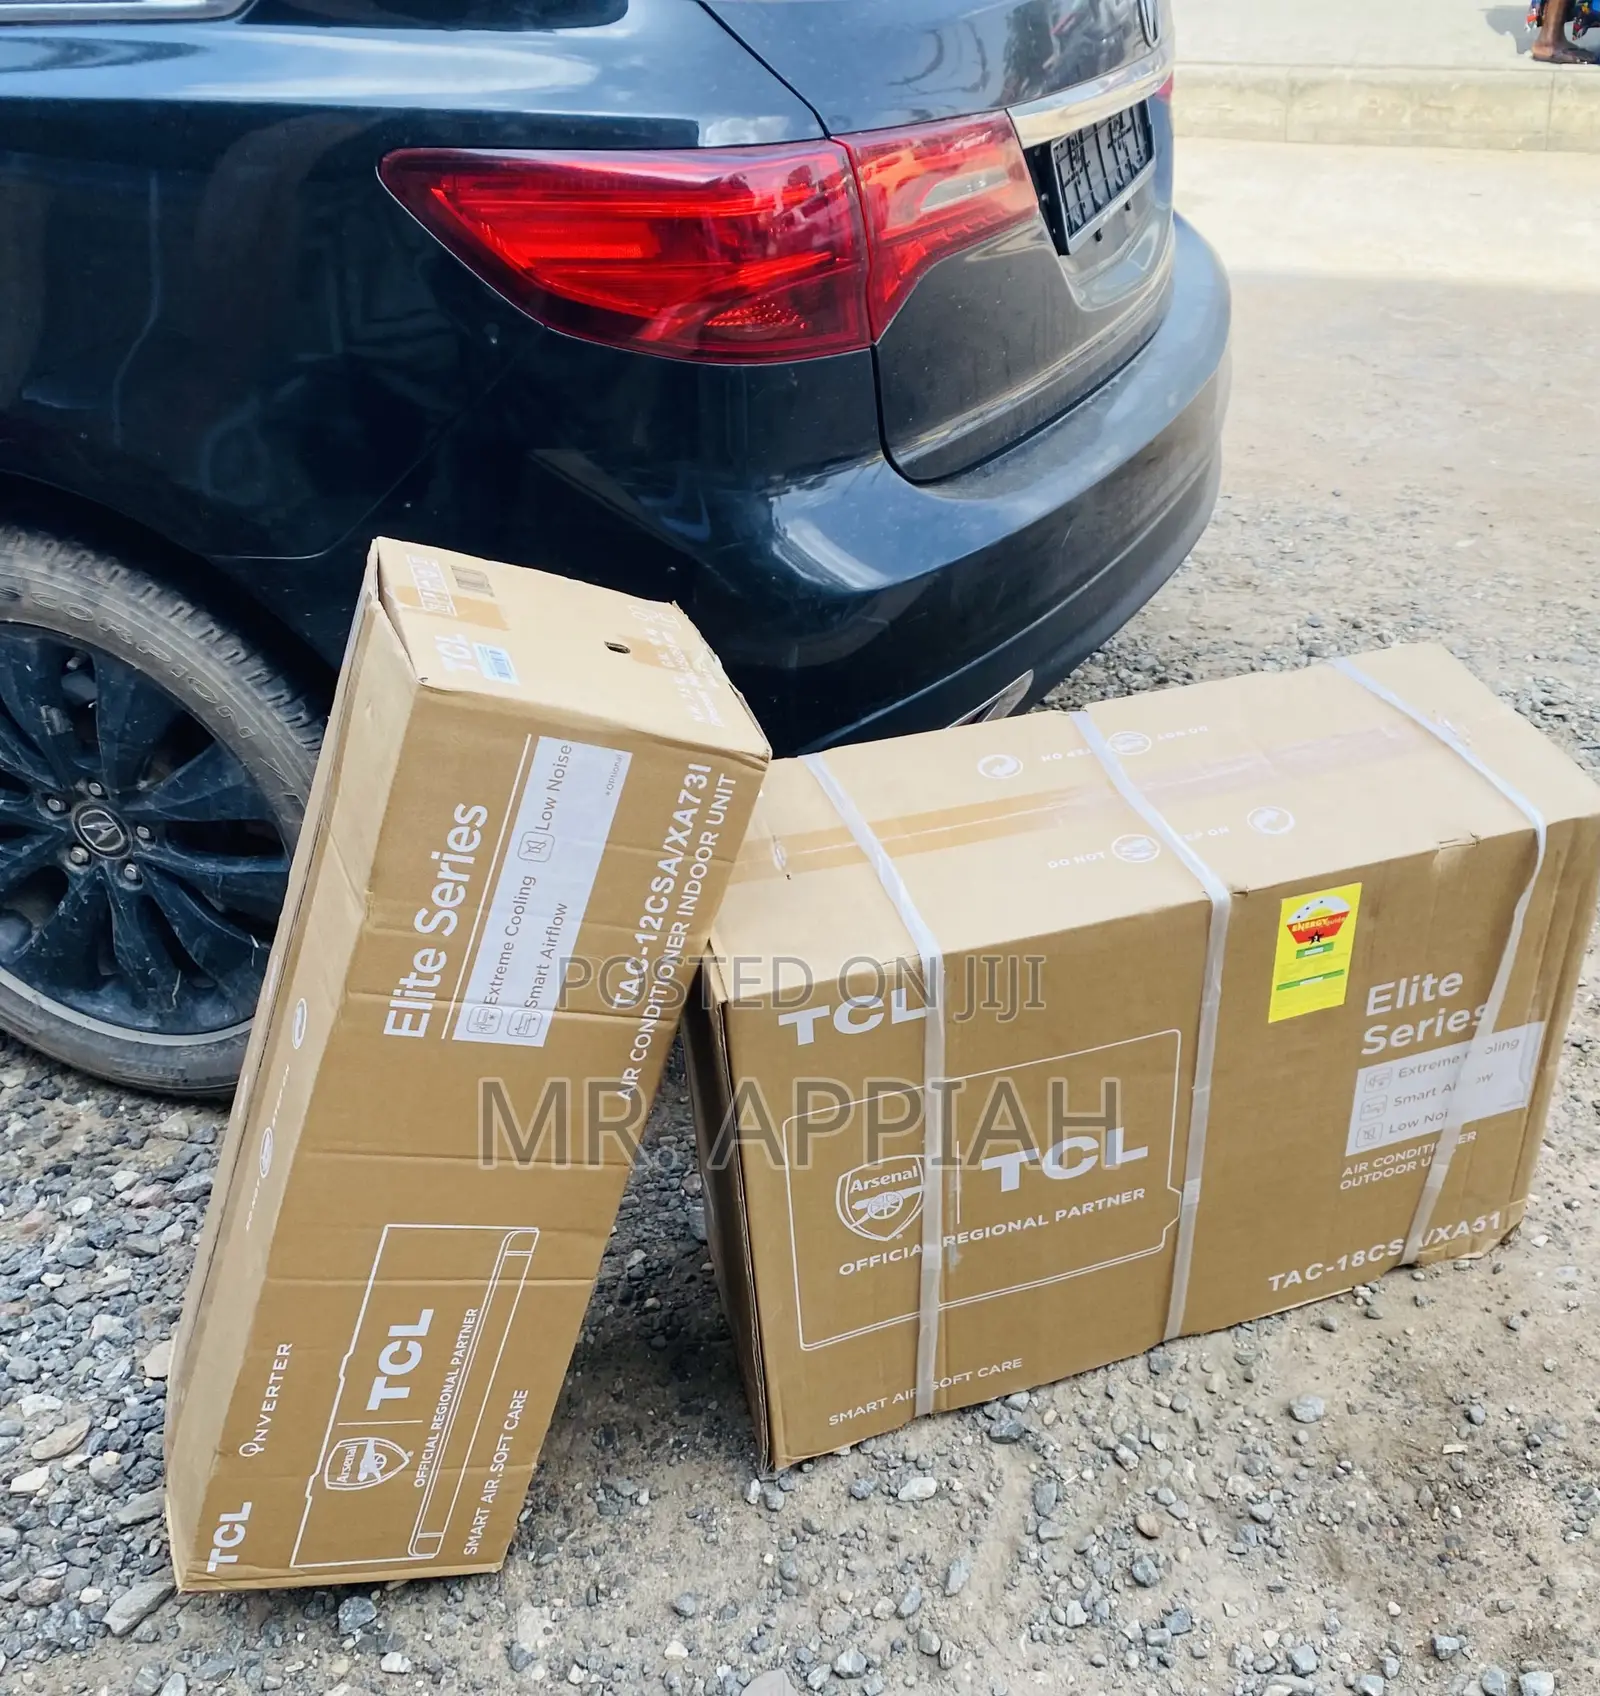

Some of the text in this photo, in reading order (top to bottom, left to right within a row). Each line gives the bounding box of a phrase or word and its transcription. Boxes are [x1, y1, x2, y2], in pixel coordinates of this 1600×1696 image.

[434, 632, 478, 674] TCL
[535, 744, 572, 831] Low Noise
[1047, 851, 1106, 869] DO NOT
[383, 803, 488, 1037] Elite Series
[483, 875, 537, 1006] Extreme Cooling
[617, 773, 737, 1101] AIR CONDITIONER INDOOR UNIT
[1291, 916, 1330, 932] ENERGY
[524, 903, 568, 1009] Smart Airflow
[778, 988, 926, 1046] TCL
[1366, 972, 1463, 1016] Elite
[1393, 1086, 1437, 1107] Smart
[1397, 1055, 1461, 1079] Extreme
[1388, 1118, 1420, 1134] Low
[849, 1165, 918, 1194] Arsenal
[981, 1126, 1149, 1193] TCL
[1340, 1160, 1417, 1190] OUTDOOR
[1341, 1161, 1369, 1178] AIR
[839, 1187, 1146, 1276] OFFICIA REGIONAL PARTNER
[366, 1308, 434, 1411] TCL
[413, 1307, 479, 1489] OFFICIAL REGIONAL PARTNER
[828, 1397, 887, 1426] SMART
[977, 1358, 1023, 1378] CARE
[336, 1445, 358, 1483] Arsenal
[463, 1507, 491, 1556] SMART
[504, 1389, 529, 1431] CARE
[206, 1501, 252, 1573] TCL
